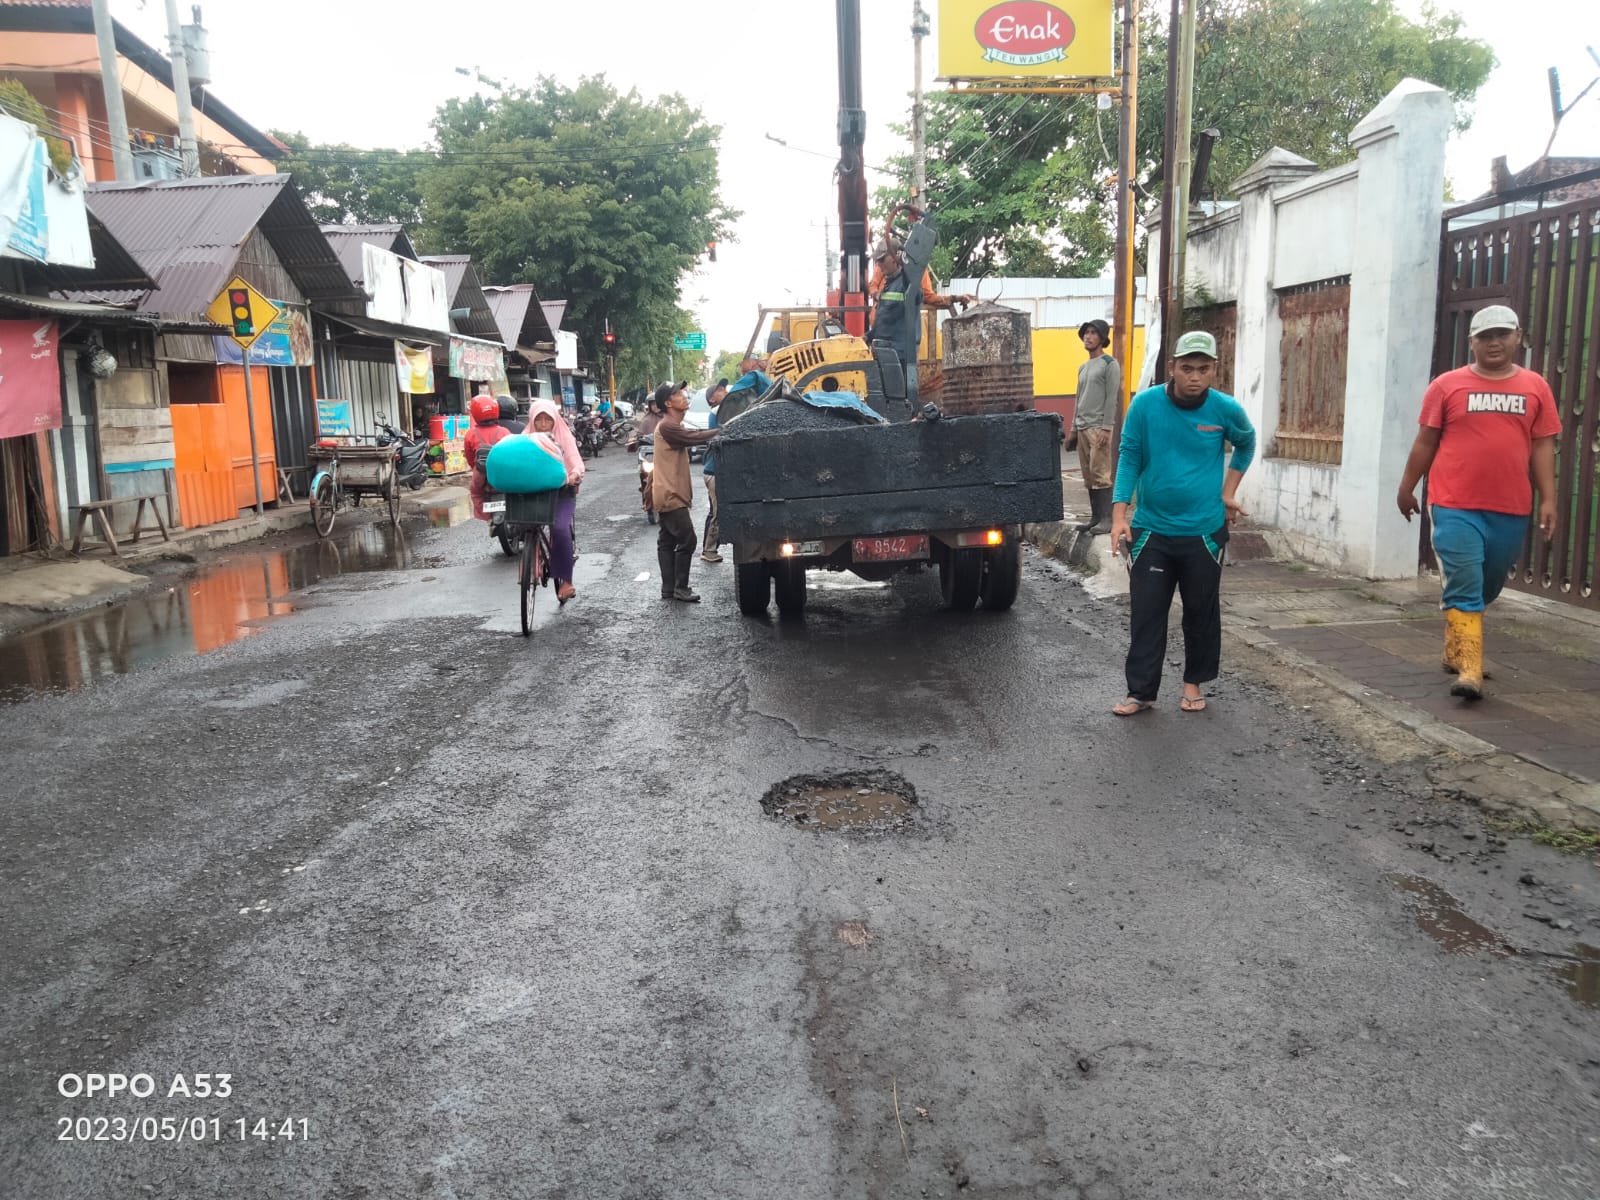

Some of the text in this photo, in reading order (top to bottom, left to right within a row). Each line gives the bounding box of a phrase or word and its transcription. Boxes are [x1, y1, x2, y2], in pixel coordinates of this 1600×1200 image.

[988, 10, 1061, 43] Enak
[994, 51, 1057, 63] TEH WANGI
[1468, 393, 1526, 414] MARVEL
